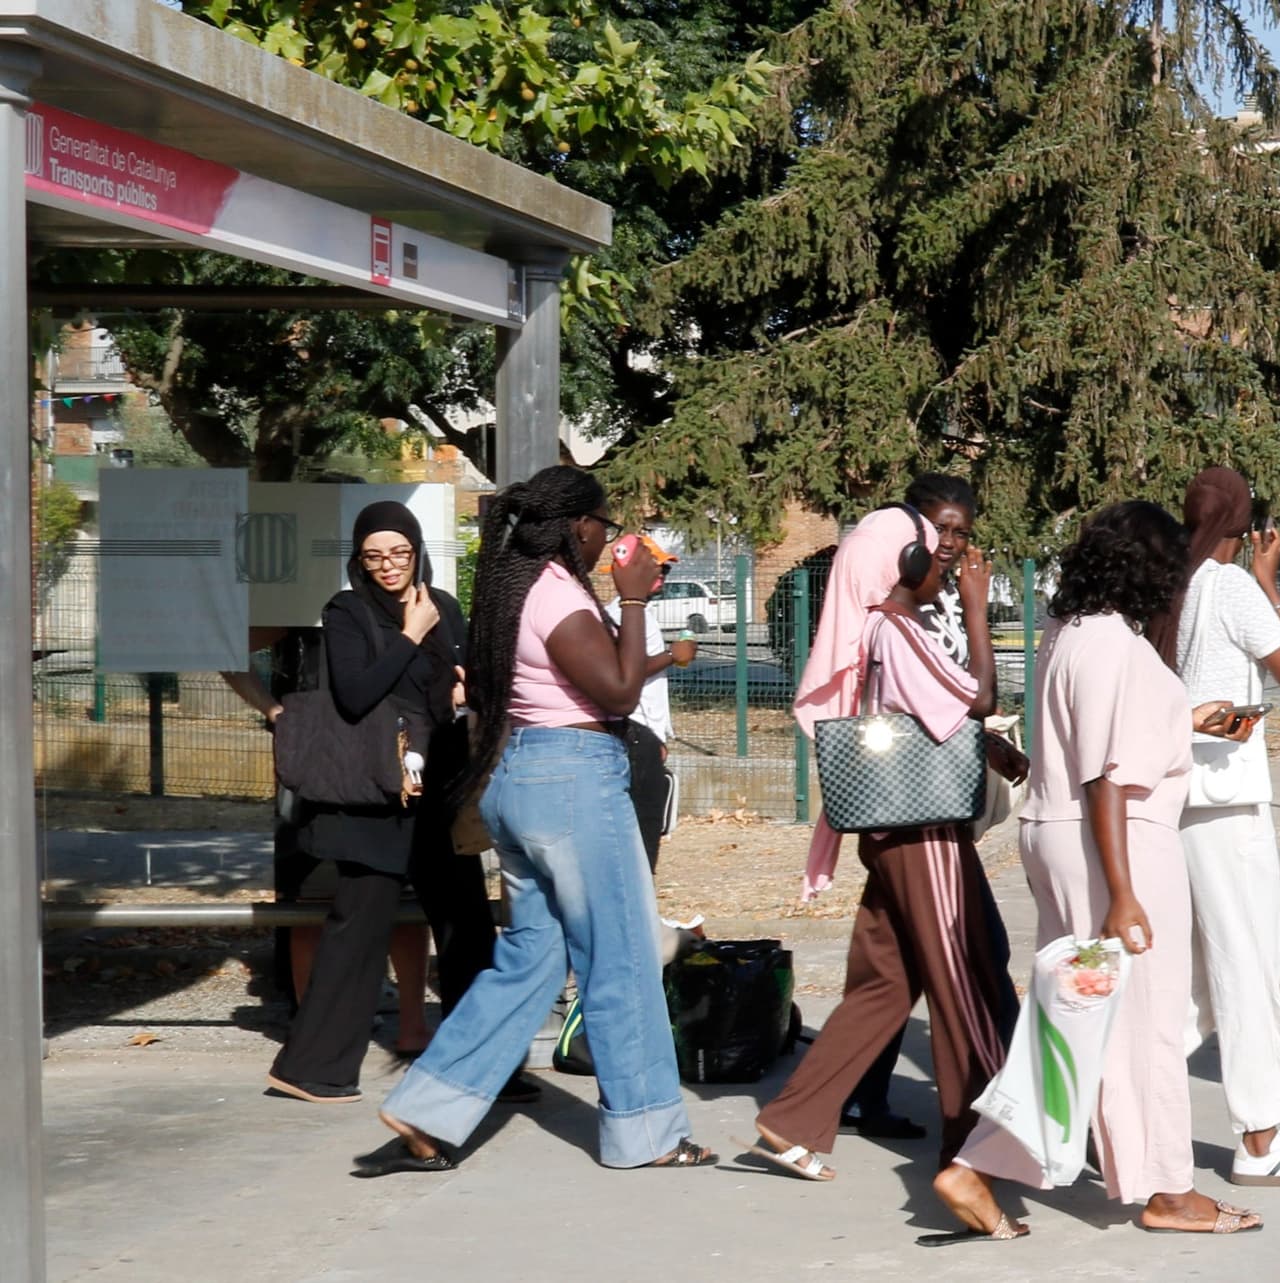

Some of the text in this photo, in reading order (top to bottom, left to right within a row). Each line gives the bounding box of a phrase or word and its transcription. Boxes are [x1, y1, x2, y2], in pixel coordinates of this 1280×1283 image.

[49, 157, 158, 211] Transports públics
[50, 126, 177, 191] Generalitat de Catalunya
